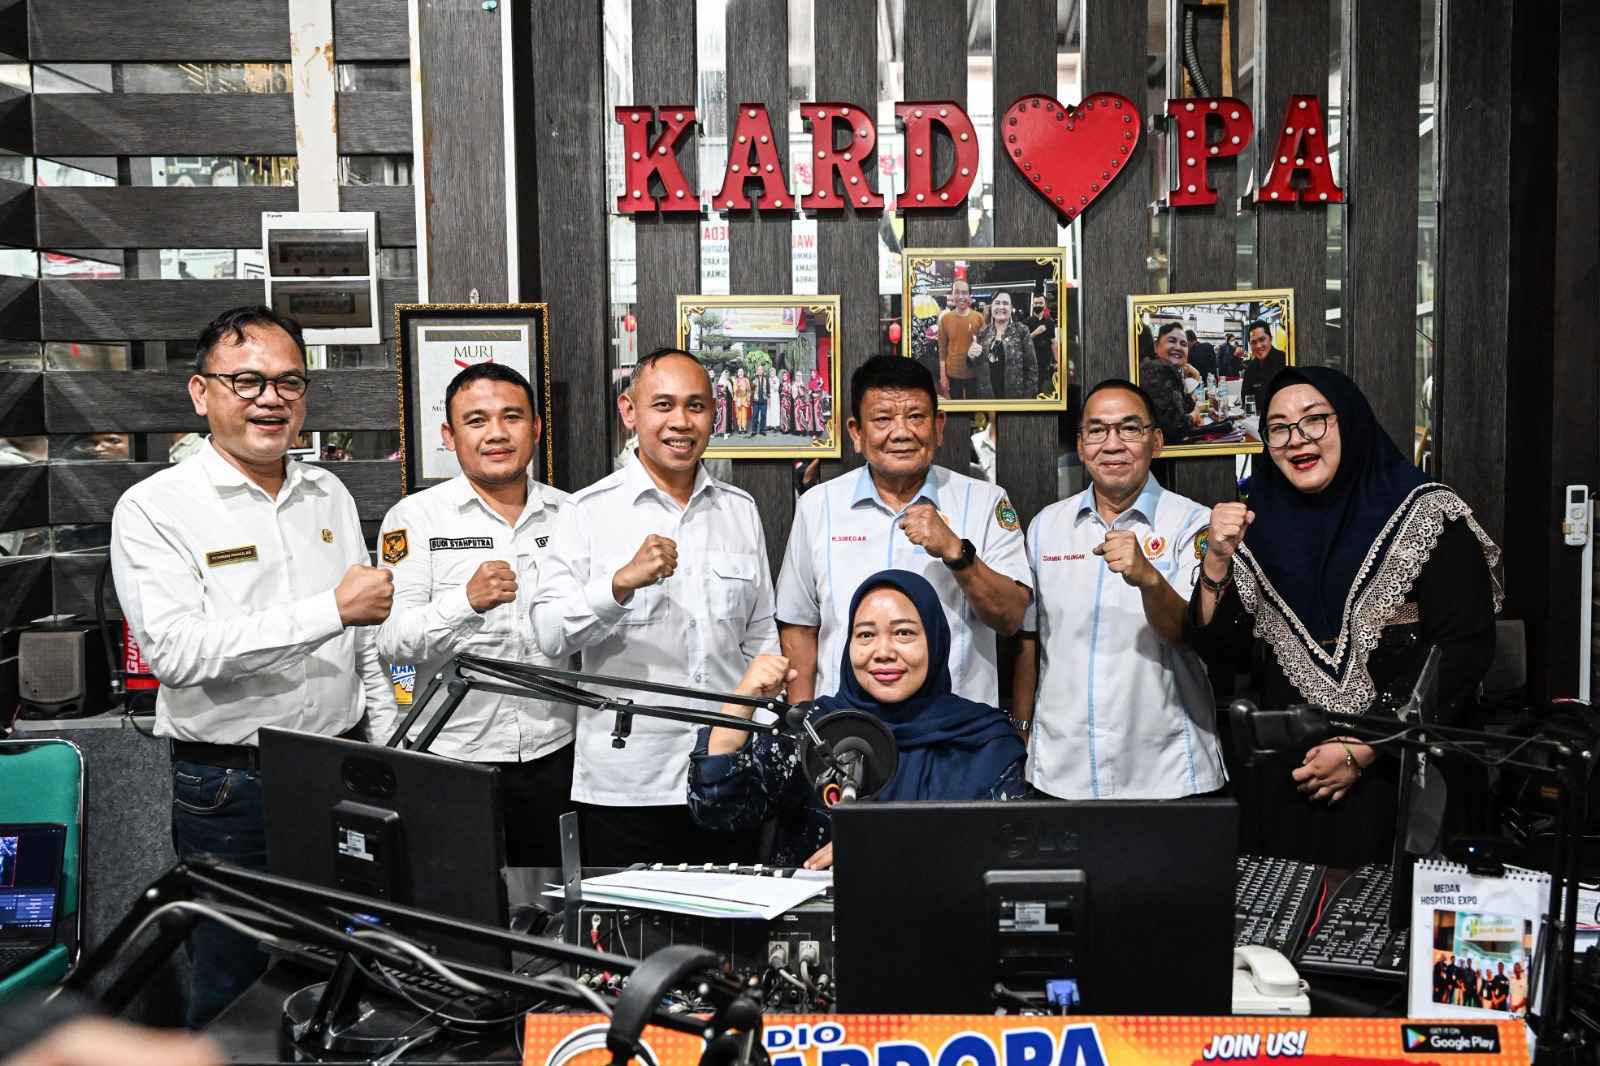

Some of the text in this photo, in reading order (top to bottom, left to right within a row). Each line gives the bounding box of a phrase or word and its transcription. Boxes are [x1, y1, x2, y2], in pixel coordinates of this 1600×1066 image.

[454, 345, 494, 359] MURI
[1433, 883, 1461, 894] MEDAN
[1420, 895, 1478, 905] HOSPITAL EXPO
[766, 1025, 843, 1049] DIO
[1203, 1029, 1308, 1060] JOIN US!
[1430, 1034, 1495, 1052] Google Play
